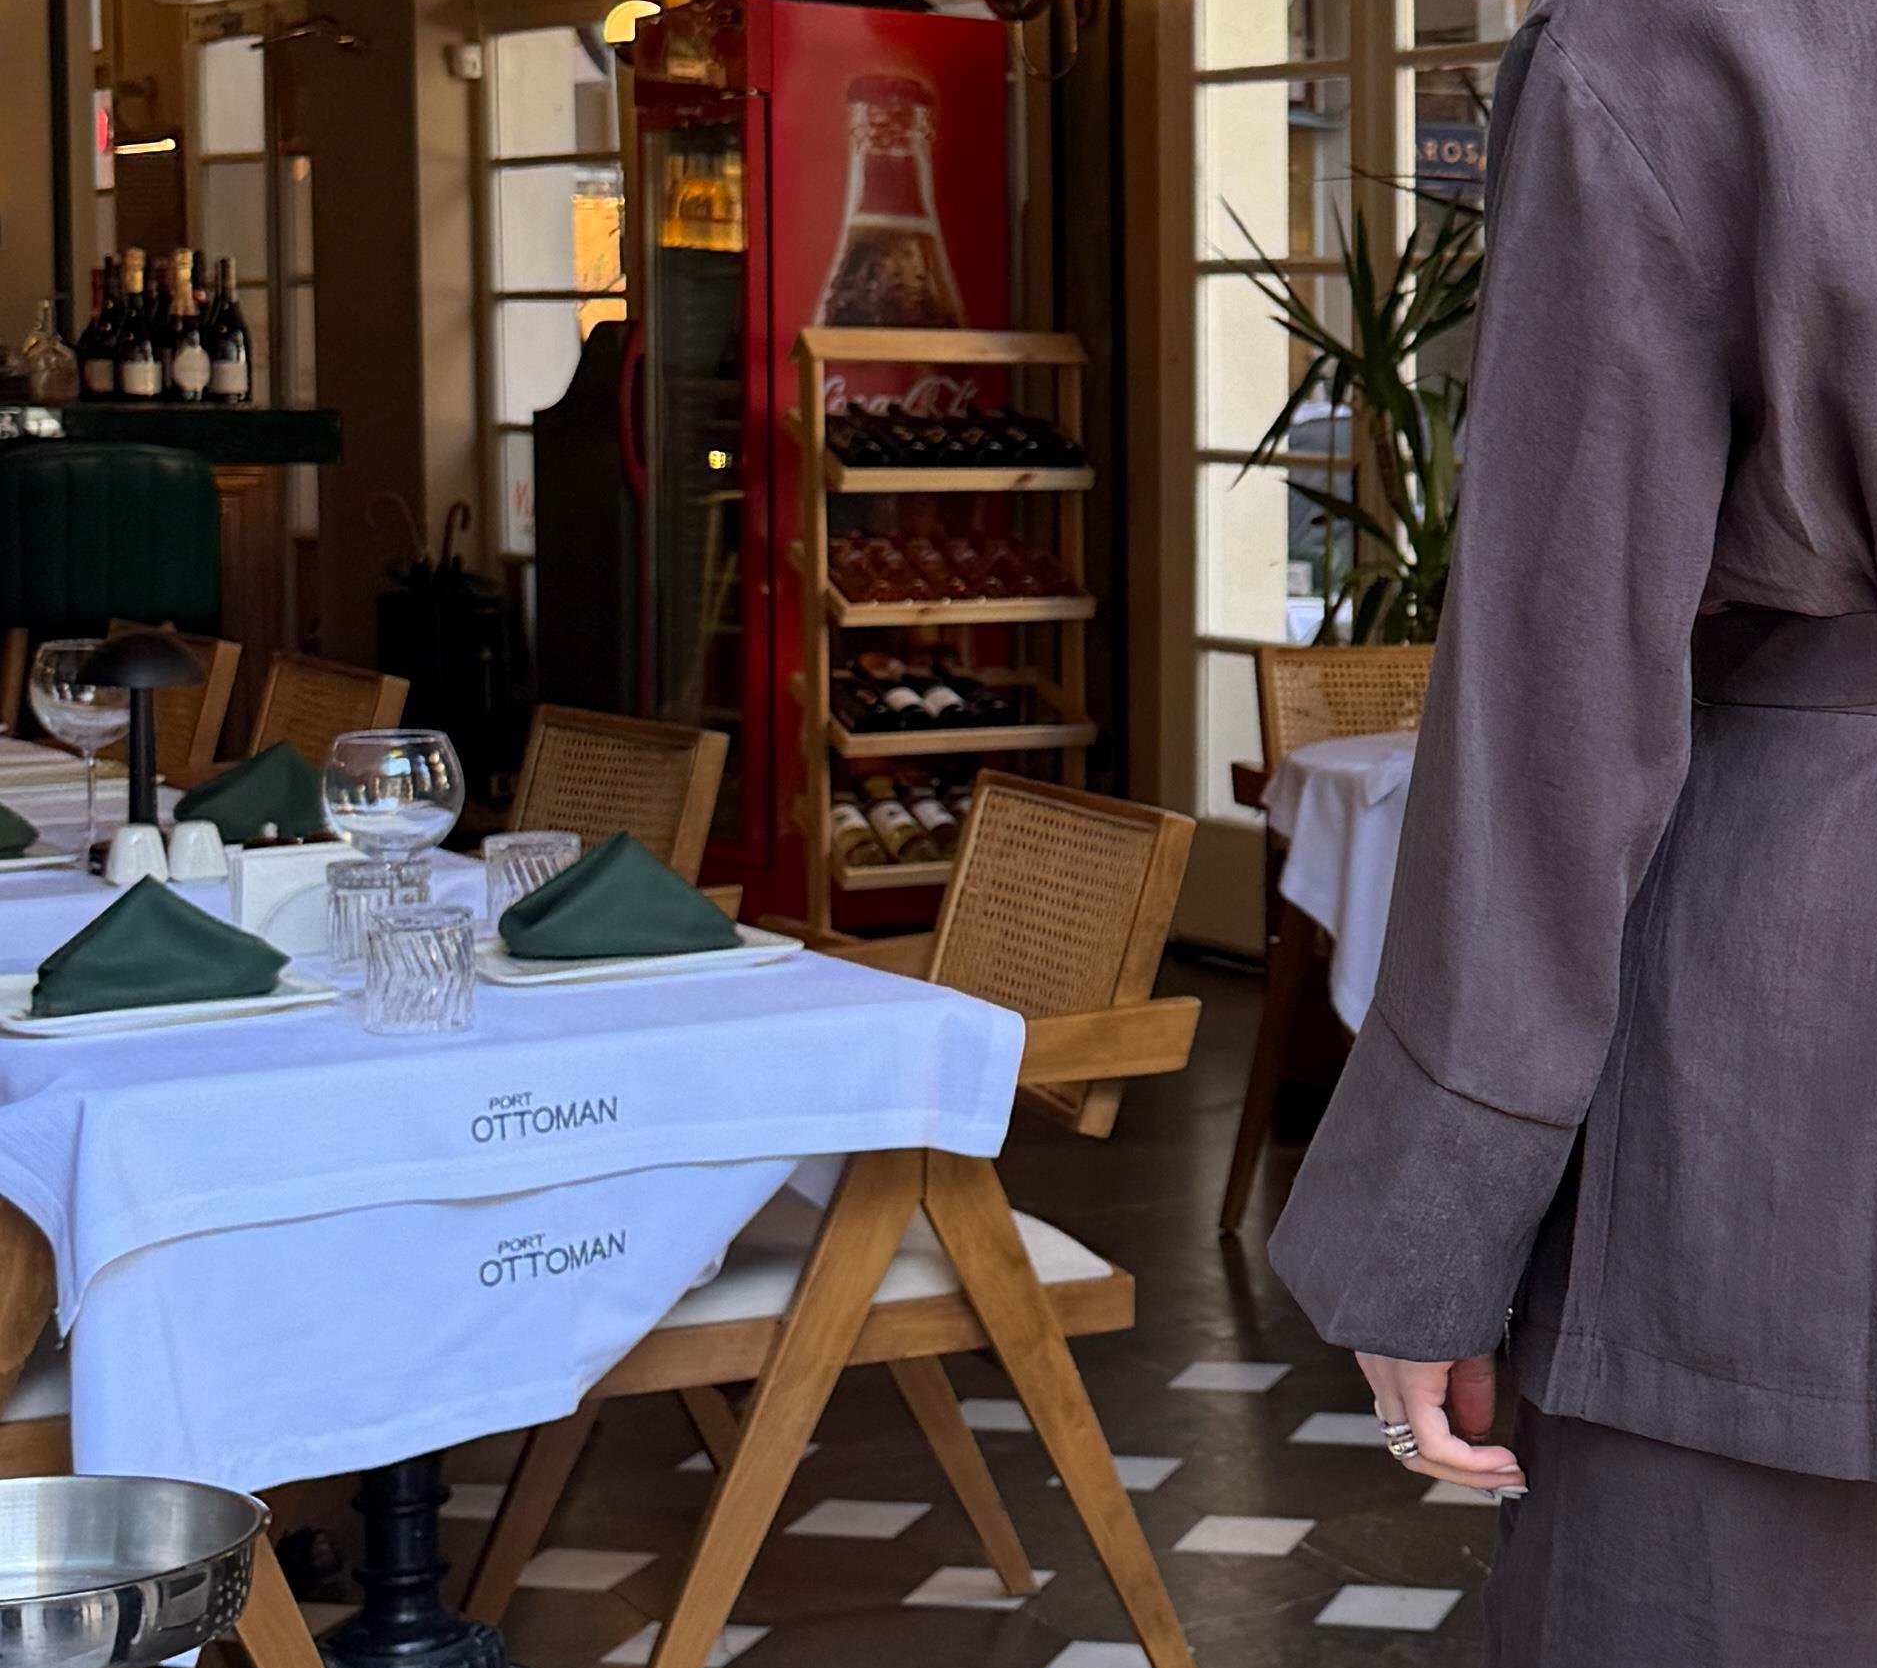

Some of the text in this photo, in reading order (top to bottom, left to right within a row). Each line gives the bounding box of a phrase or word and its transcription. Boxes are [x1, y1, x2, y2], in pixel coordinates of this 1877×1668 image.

[489, 1091, 533, 1110] PORT
[472, 1096, 618, 1142] OTTOMAN
[480, 1230, 626, 1287] OTTOMAN
[498, 1234, 545, 1253] PORT
